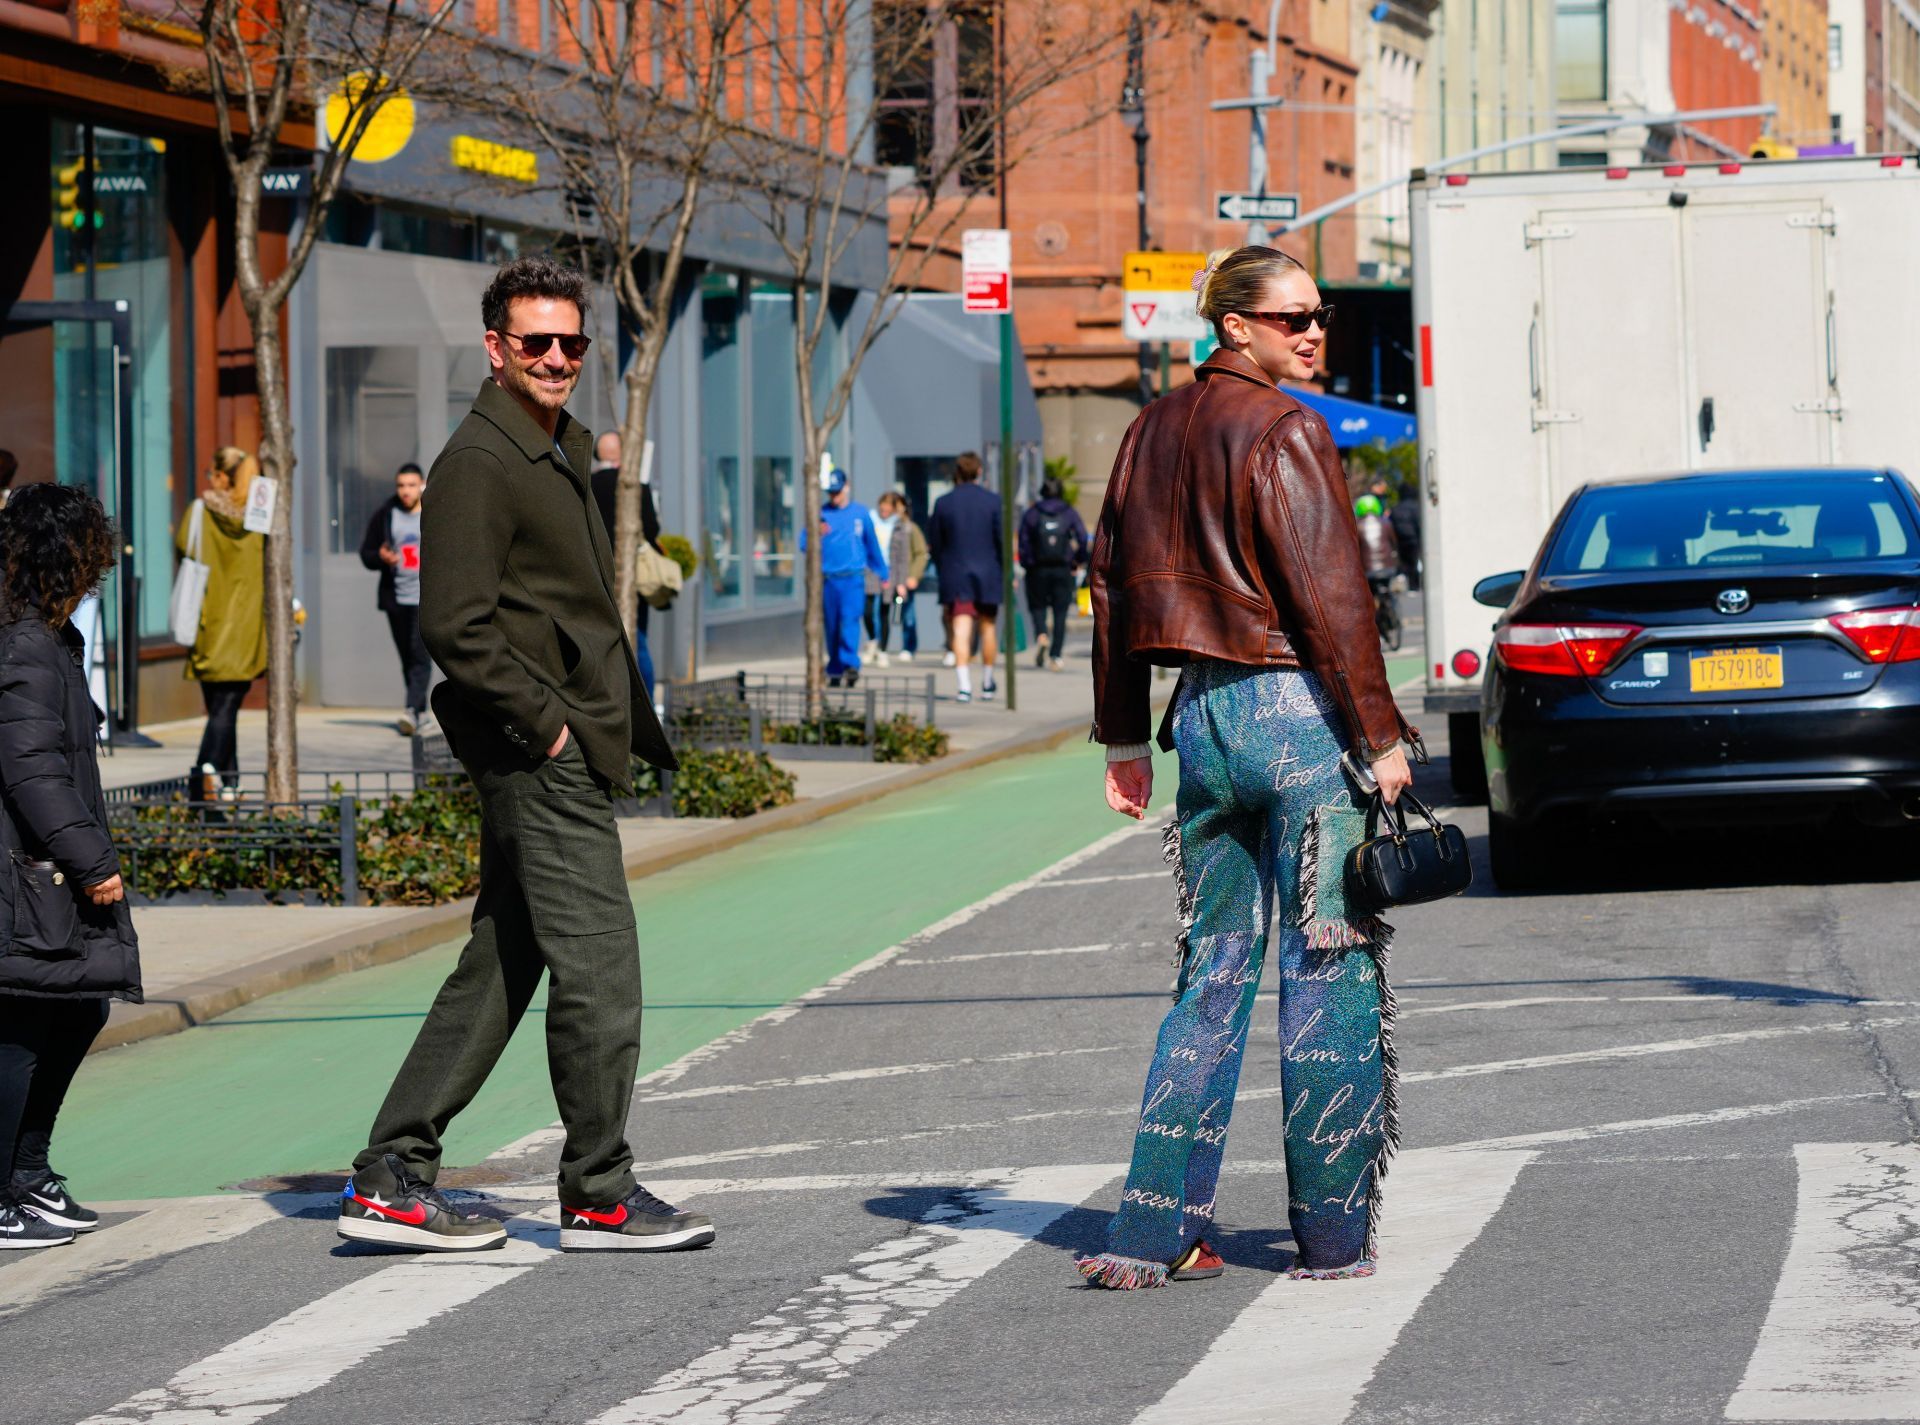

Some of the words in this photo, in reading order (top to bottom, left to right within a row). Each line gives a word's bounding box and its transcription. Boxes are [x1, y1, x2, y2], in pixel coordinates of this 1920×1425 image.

[1700, 657, 1773, 682] T757918C
[1610, 680, 1661, 689] CAMRY
[1265, 742, 1323, 791] too
